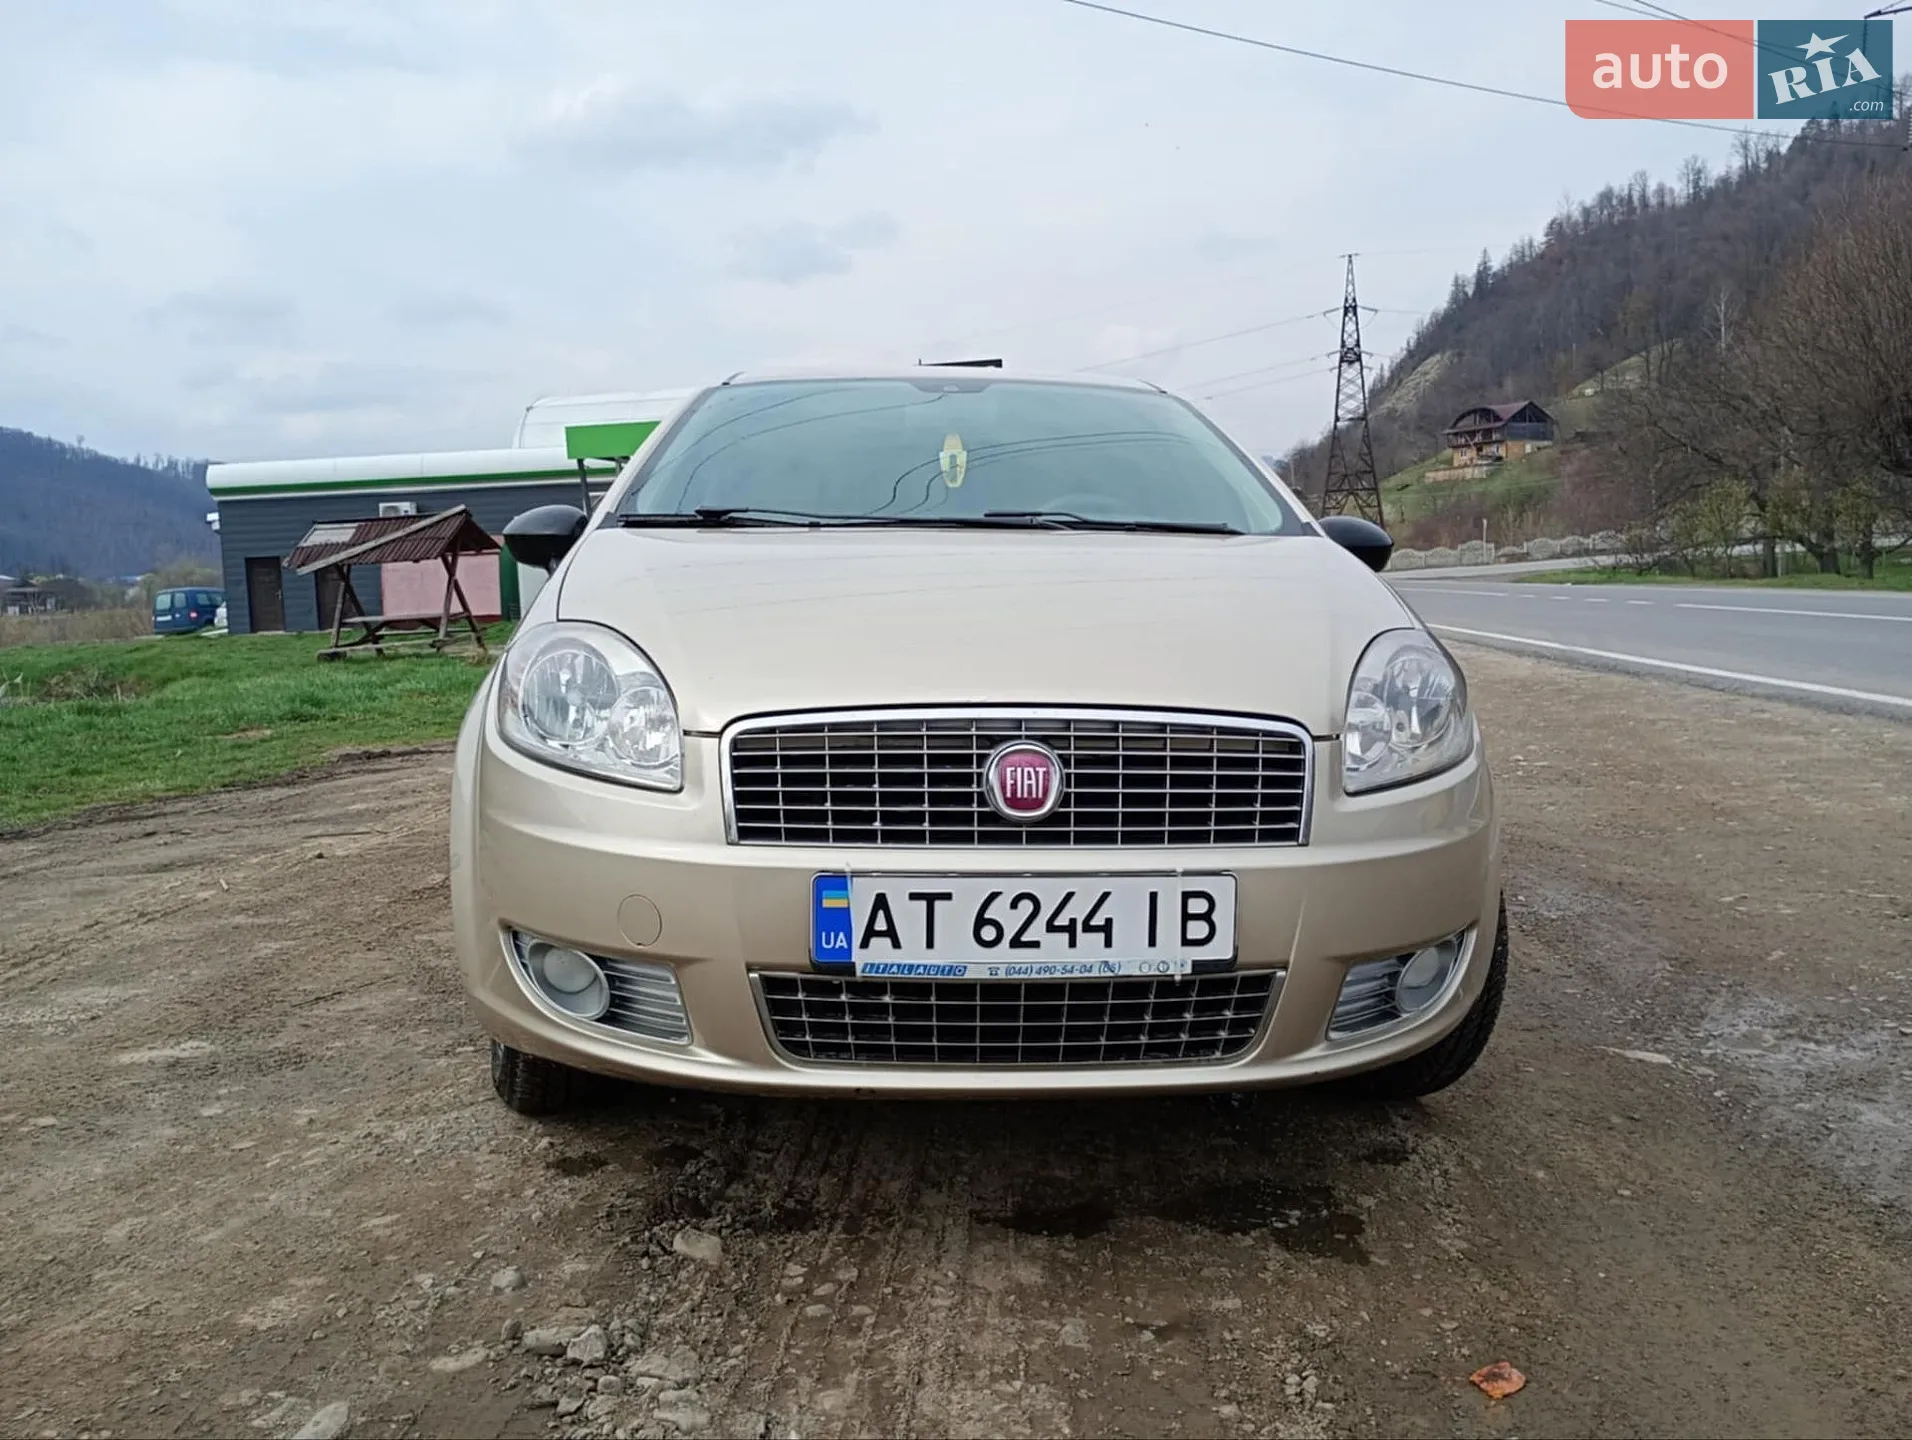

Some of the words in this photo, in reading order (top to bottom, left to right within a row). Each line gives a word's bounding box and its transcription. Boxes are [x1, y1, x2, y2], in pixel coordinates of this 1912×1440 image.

[1006, 767, 1046, 798] FIAT
[859, 892, 952, 950] AT
[972, 891, 1113, 950] 6244
[1147, 891, 1217, 949] IB
[821, 931, 848, 949] UA
[862, 962, 967, 976] ITALAUTO
